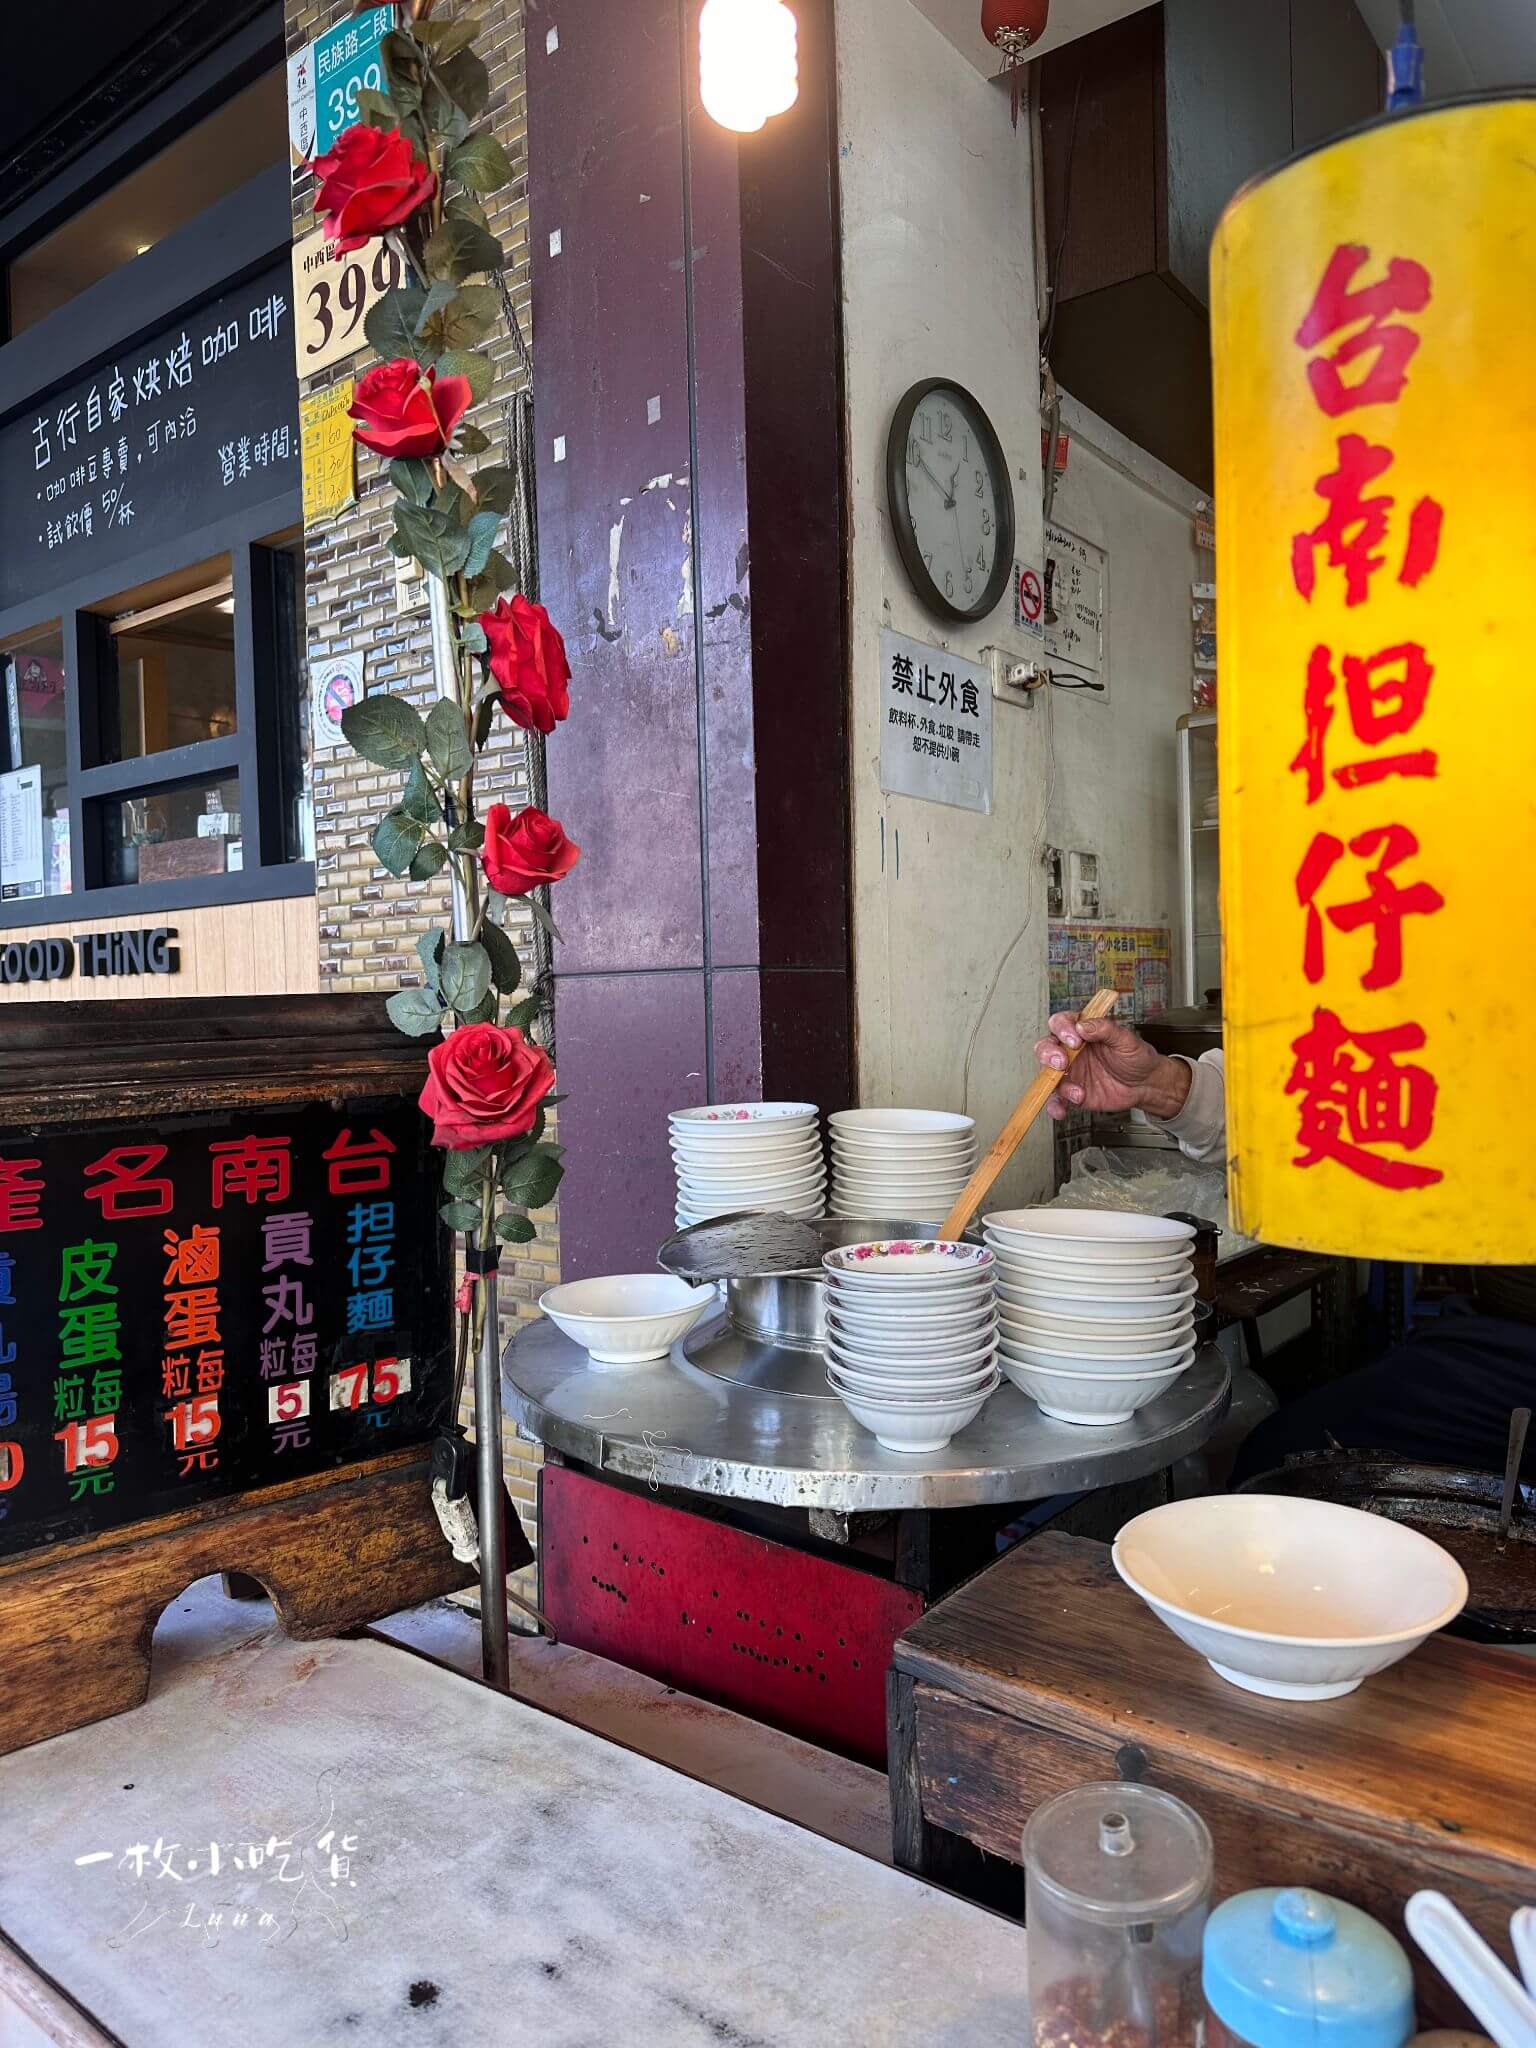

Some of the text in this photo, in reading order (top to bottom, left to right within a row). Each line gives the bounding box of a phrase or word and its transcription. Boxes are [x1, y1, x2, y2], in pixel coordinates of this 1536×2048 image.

[317, 10, 388, 79] 民族路二段
[305, 247, 401, 354] 399
[32, 294, 287, 470] 古行自家烘焙咖啡
[892, 652, 979, 718] 禁止外食
[1284, 243, 1445, 1190] 台南担仔麵
[912, 735, 960, 763] 恕不提供小碗
[957, 727, 981, 748] 請帶走
[0, 937, 70, 983] OOD
[58, 1238, 122, 1369] 皮蛋
[163, 1224, 222, 1351] 滷蛋
[261, 1211, 314, 1334] 貢丸
[340, 1201, 399, 1429] 担仔麵 75 元
[164, 1393, 222, 1451] 15
[275, 1382, 302, 1420] 5
[54, 1412, 120, 1473] 15
[176, 1441, 219, 1477] 元
[271, 1421, 311, 1454] 元
[68, 1465, 116, 1502] 元
